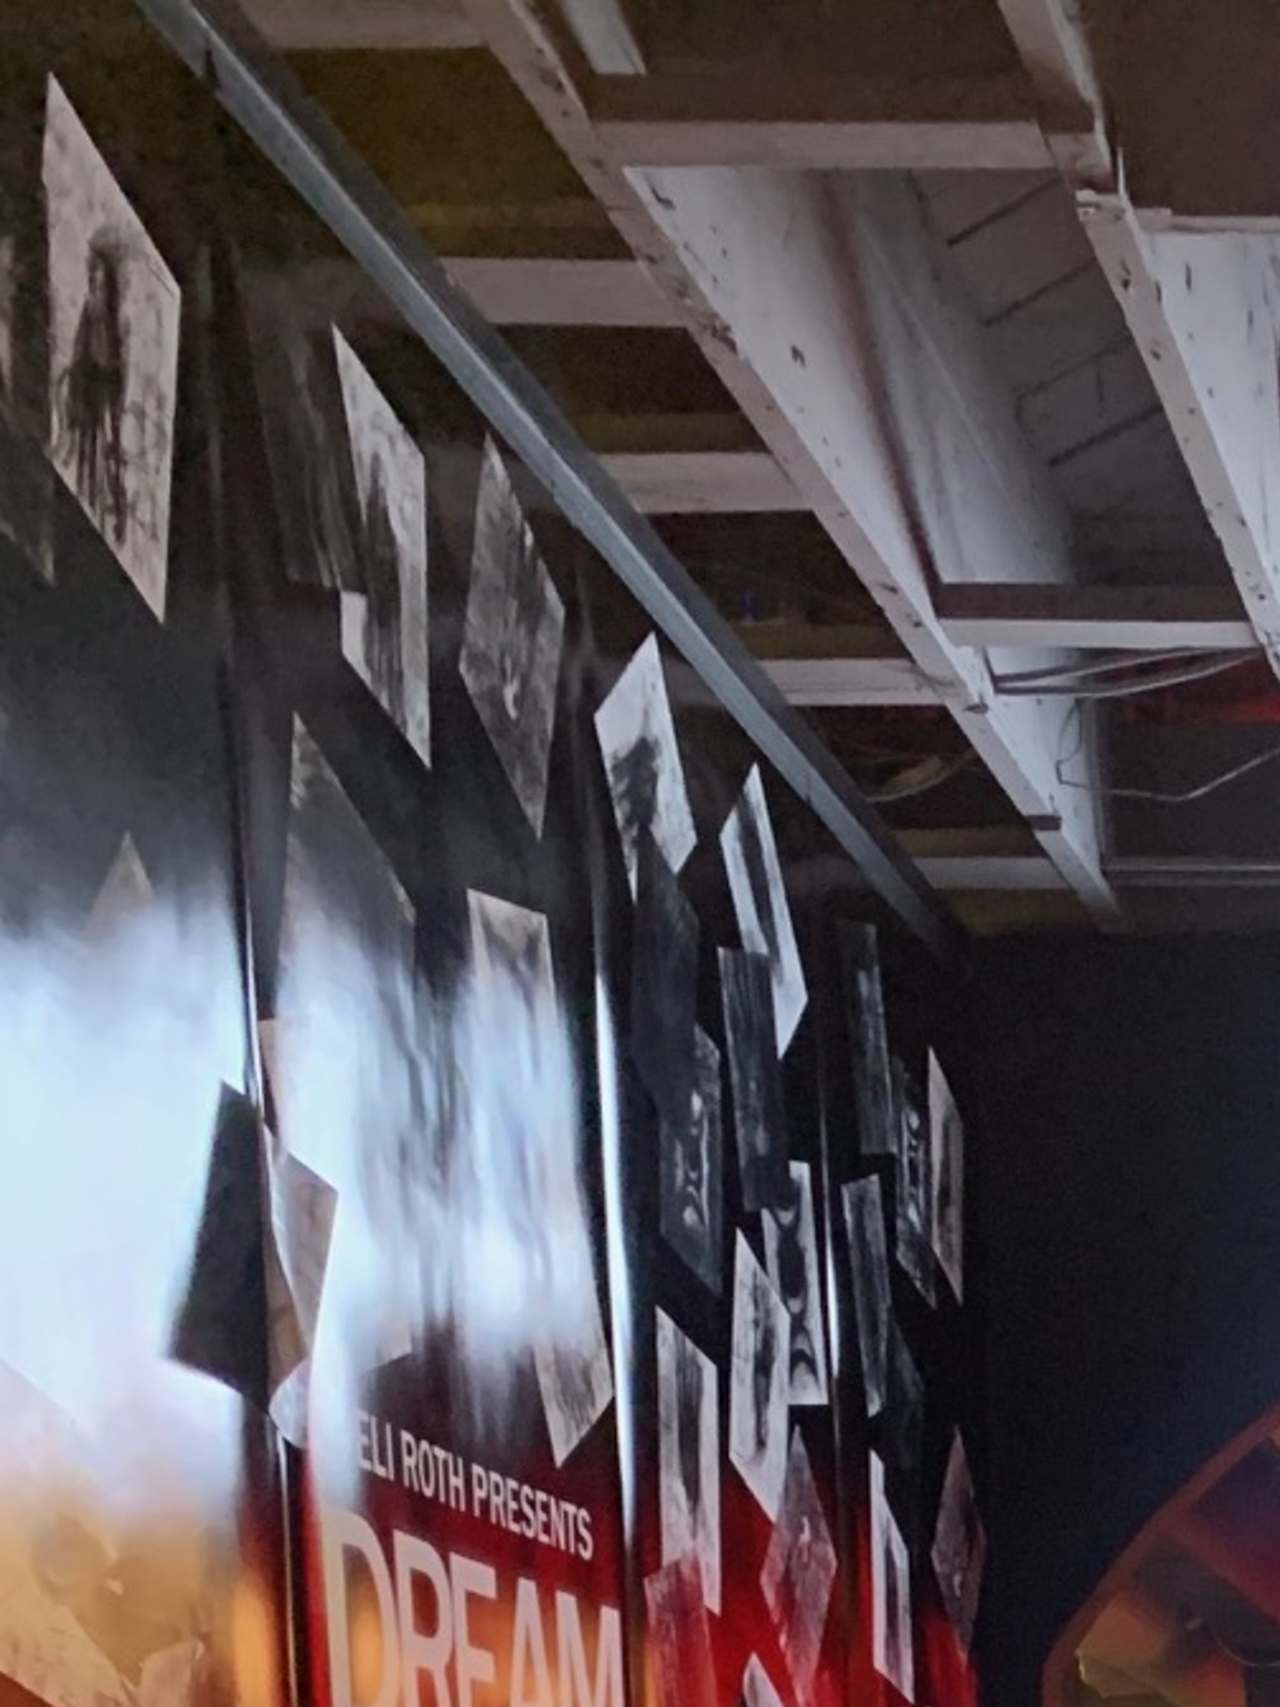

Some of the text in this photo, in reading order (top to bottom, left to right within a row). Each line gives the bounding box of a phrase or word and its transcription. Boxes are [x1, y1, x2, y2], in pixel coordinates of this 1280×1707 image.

[359, 1410, 593, 1561] ELI ROTH PRESENTS
